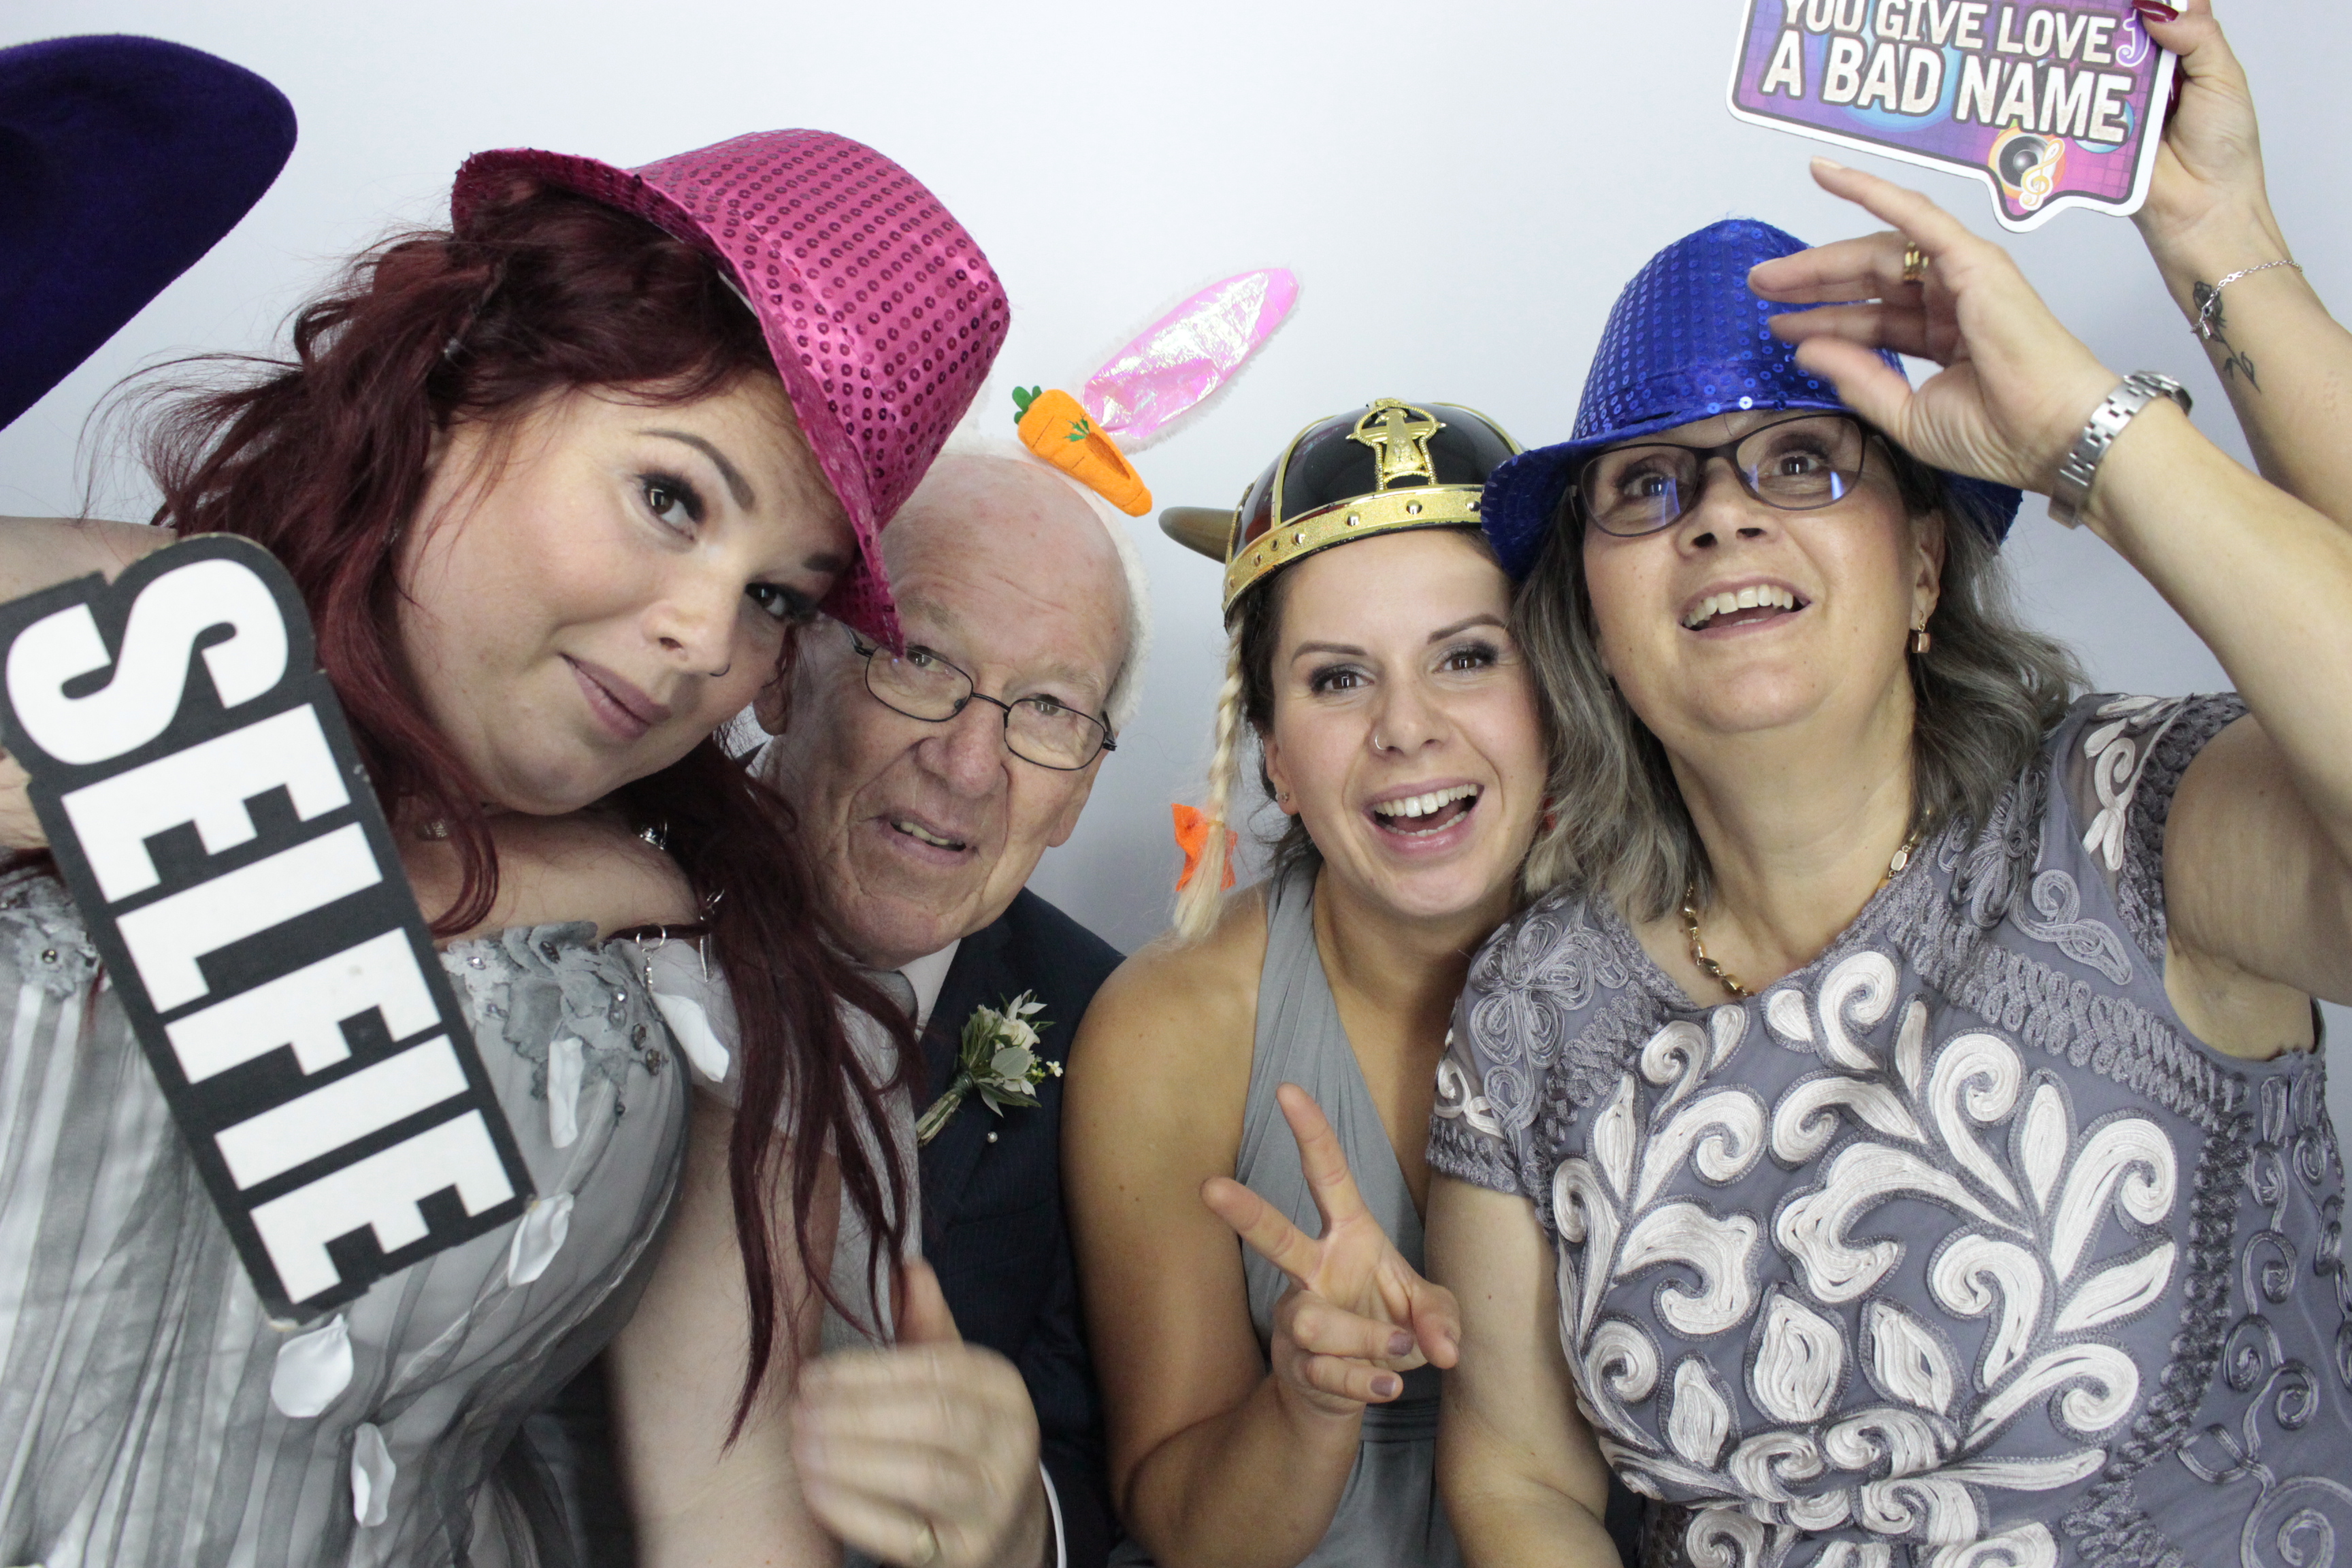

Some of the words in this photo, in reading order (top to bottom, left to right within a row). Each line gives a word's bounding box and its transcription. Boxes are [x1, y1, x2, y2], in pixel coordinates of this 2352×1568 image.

[1762, 29, 1801, 97] A
[1823, 36, 1942, 114] BAD
[1956, 54, 2132, 142] NAME
[1784, 0, 1865, 33] YOU
[1874, 0, 1988, 49] GIVE
[1996, 6, 2117, 63] LOVE
[5, 558, 515, 1304] SELFIE
